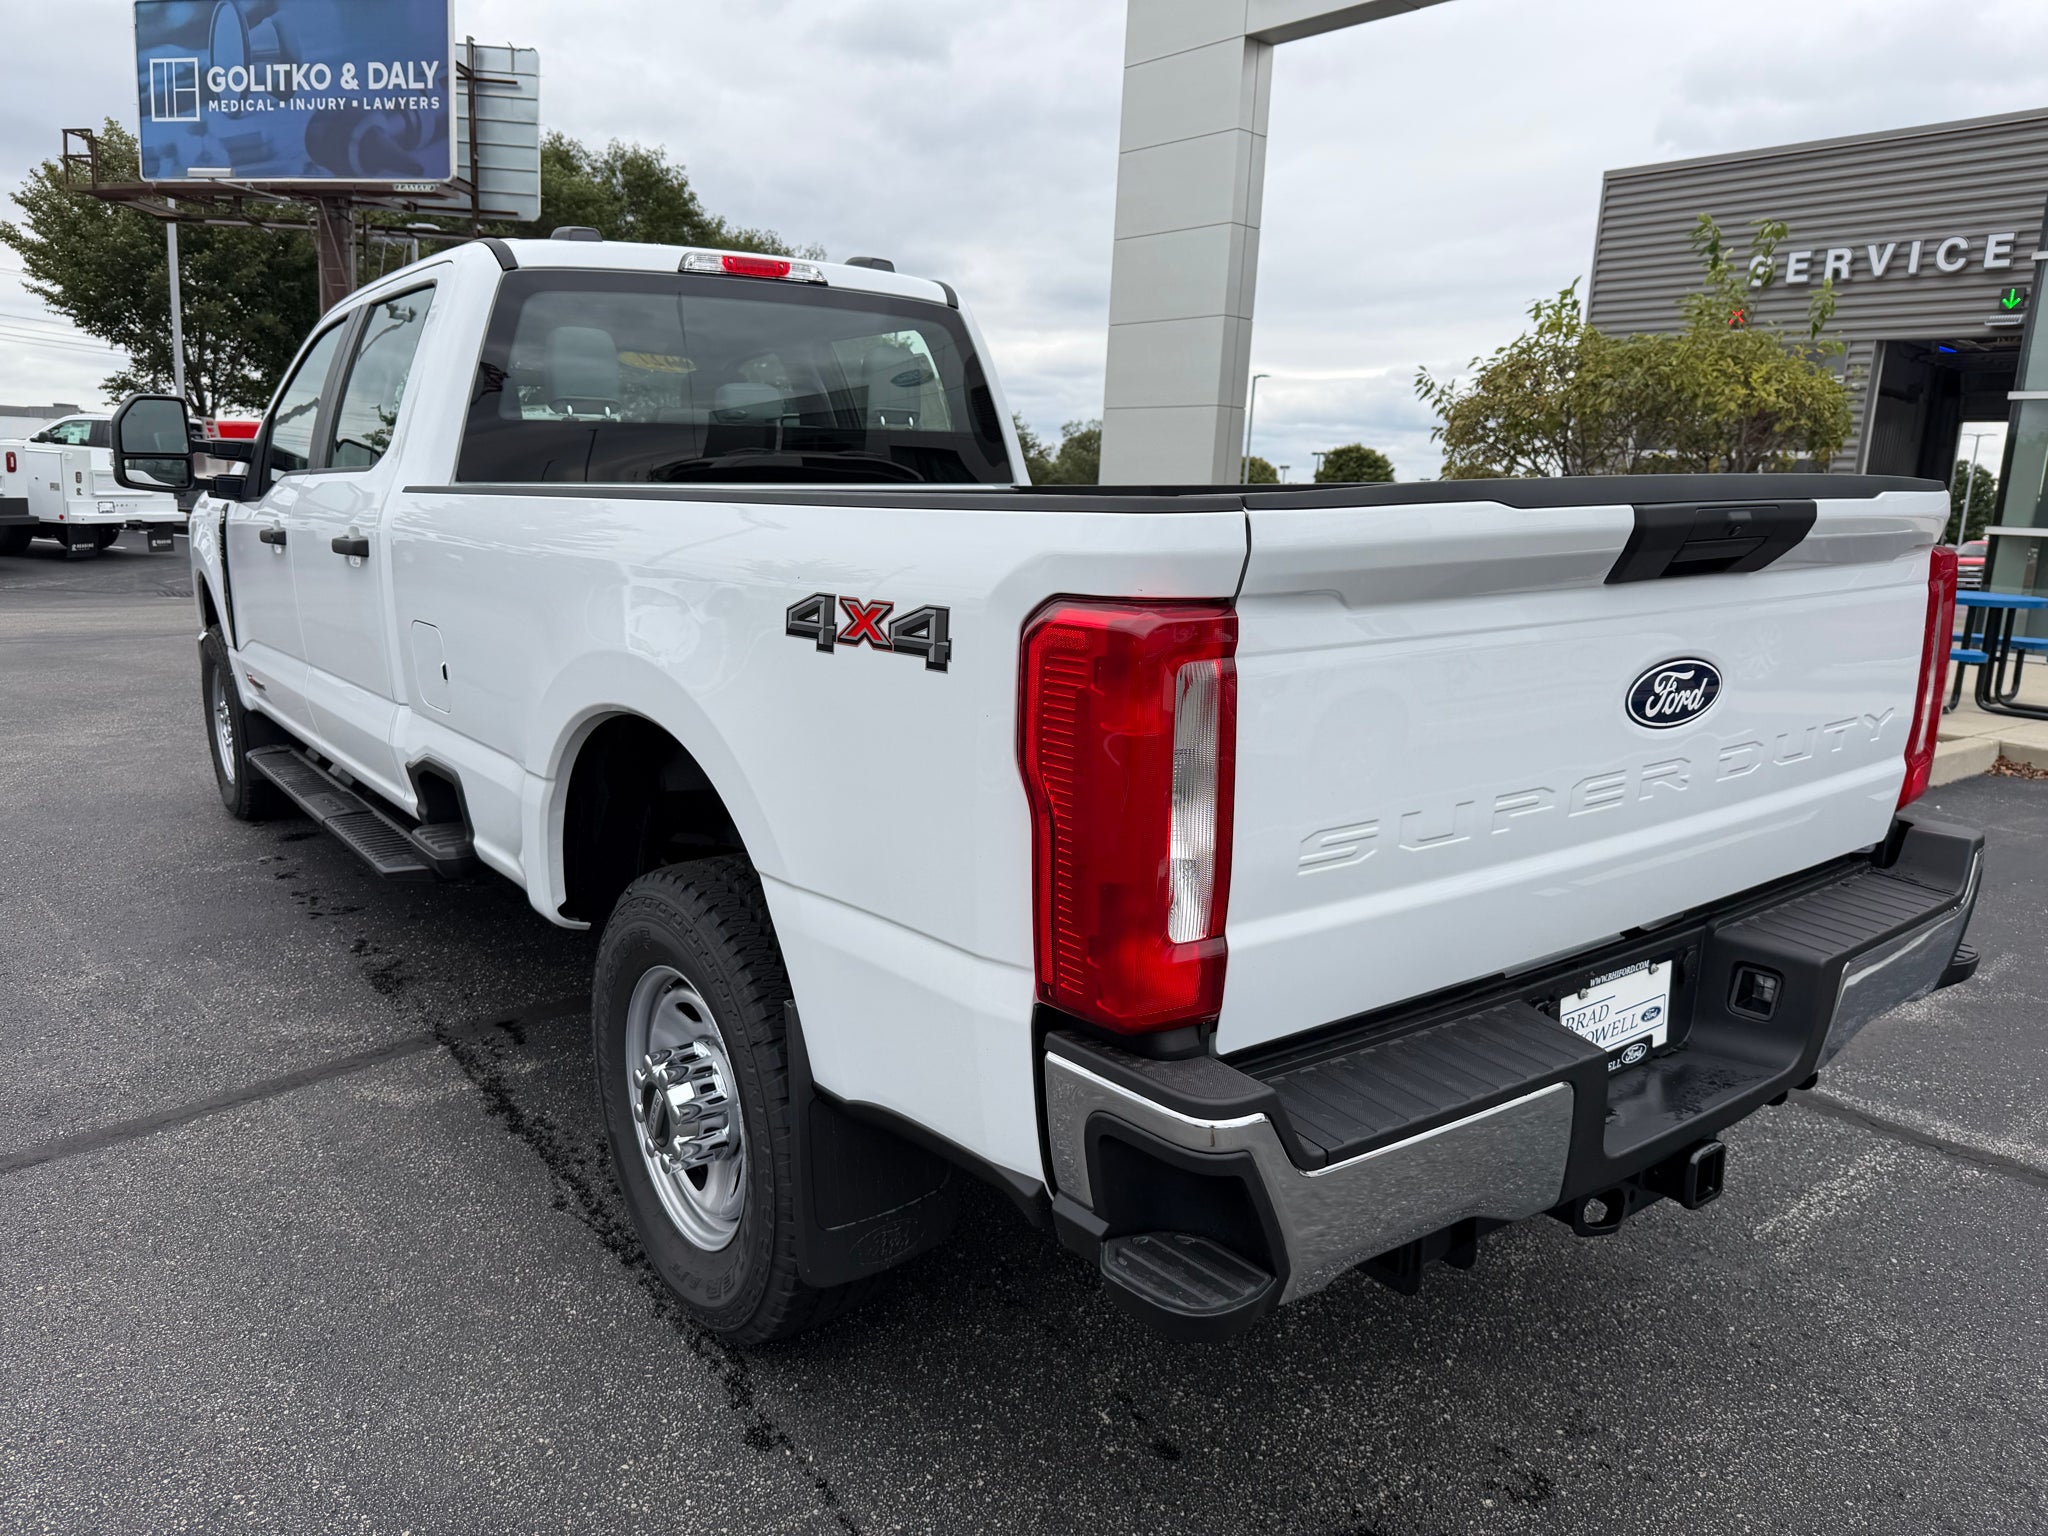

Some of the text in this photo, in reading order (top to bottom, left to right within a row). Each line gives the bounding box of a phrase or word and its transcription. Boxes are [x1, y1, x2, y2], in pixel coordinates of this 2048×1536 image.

[207, 61, 439, 92] GOLITKO & DALY
[208, 96, 440, 112] MEDICAL INJURY LAWYERS
[1645, 669, 1709, 718] Ford
[1298, 706, 1894, 876] SUPER DUTY
[1566, 1004, 1610, 1032] BRAD
[1582, 1007, 1661, 1044] OWELL Ford
